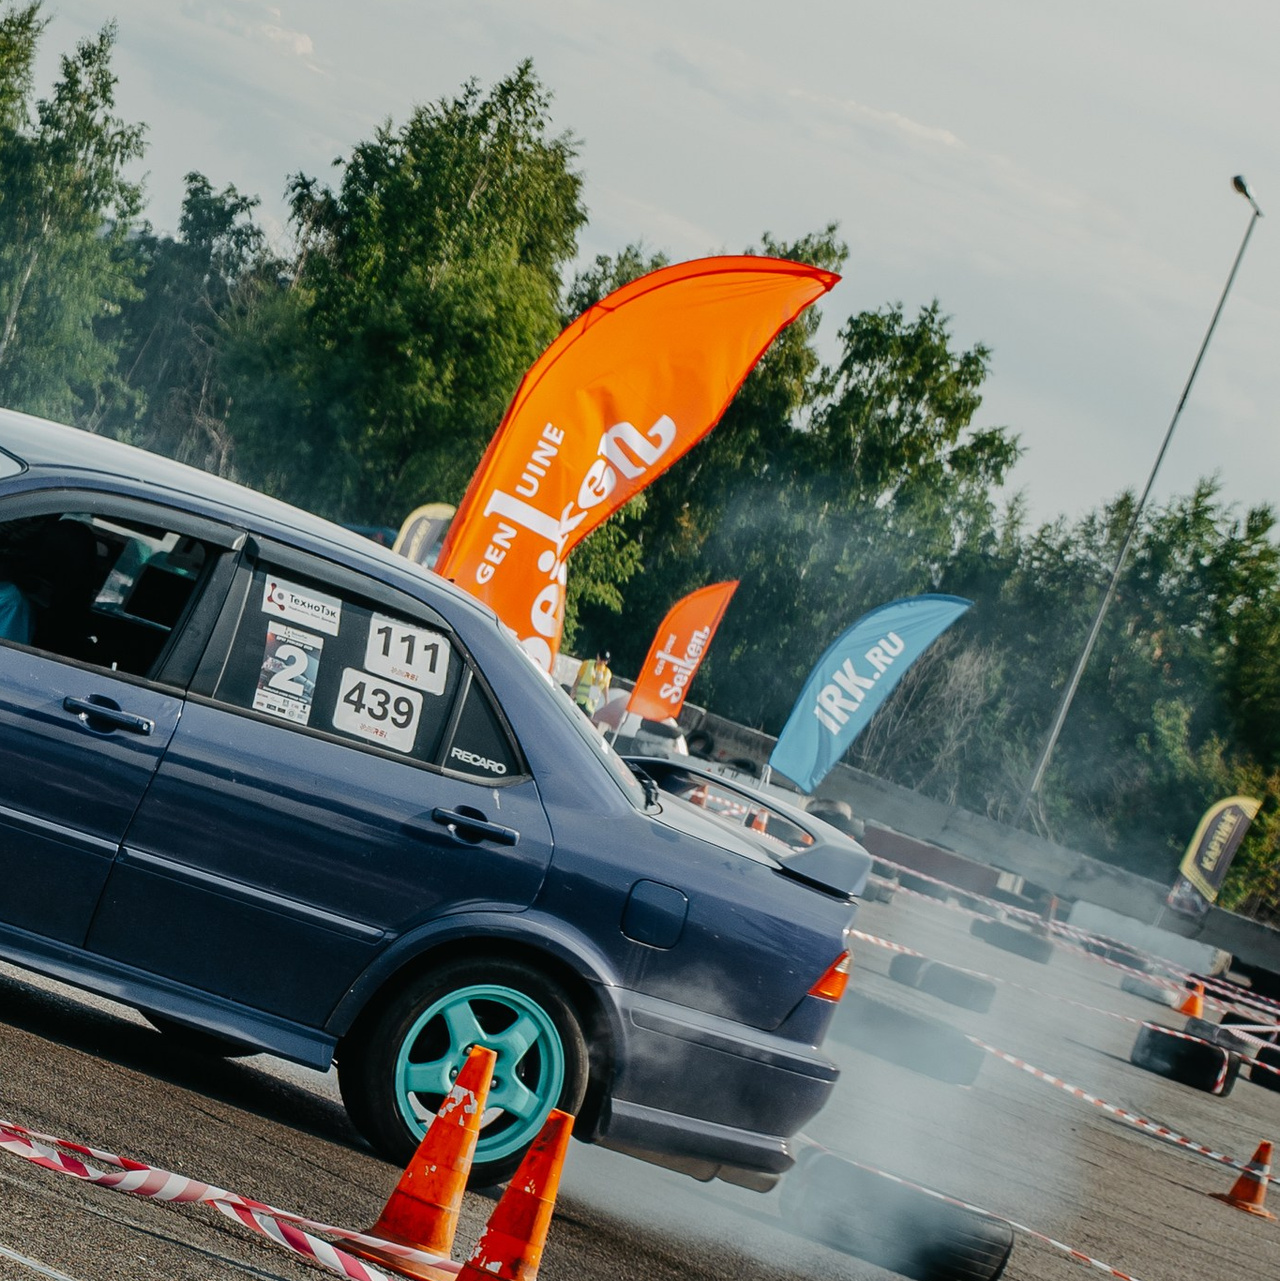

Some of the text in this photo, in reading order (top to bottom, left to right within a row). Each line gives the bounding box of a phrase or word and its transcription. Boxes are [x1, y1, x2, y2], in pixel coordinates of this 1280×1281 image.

[268, 644, 308, 697] 2
[377, 626, 439, 674] 111
[660, 625, 710, 704] Seiken
[343, 681, 414, 729] 439
[813, 631, 905, 736] IRK.RU
[451, 747, 507, 774] RECARO
